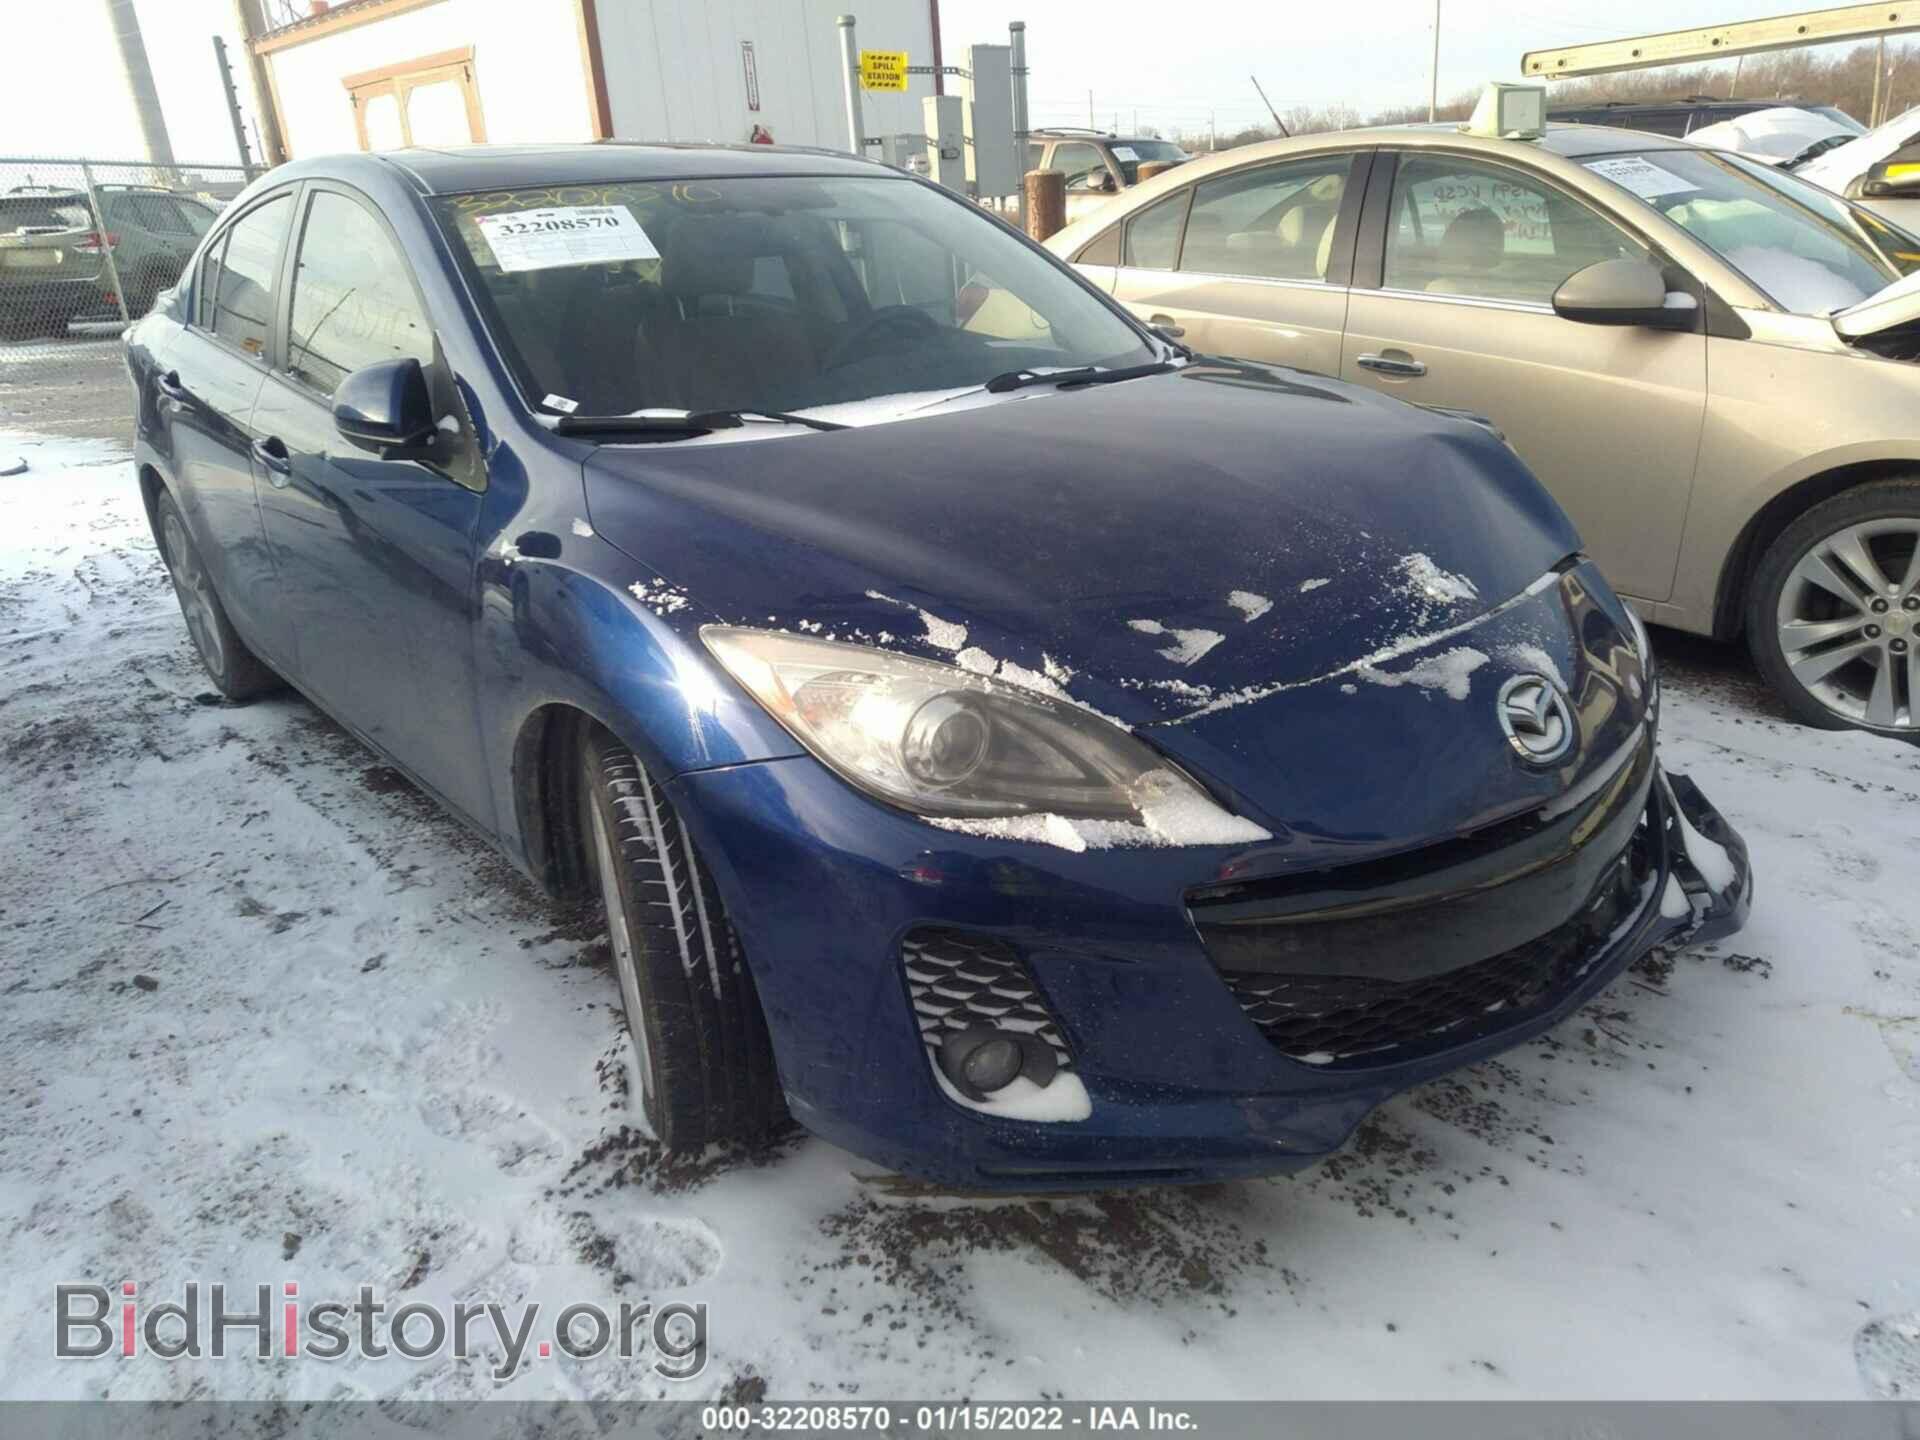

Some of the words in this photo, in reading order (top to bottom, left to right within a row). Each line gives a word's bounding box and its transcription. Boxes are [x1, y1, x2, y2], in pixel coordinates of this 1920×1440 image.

[872, 61, 896, 71] SPILL
[866, 72, 901, 81] STATION
[499, 215, 620, 237] 32208570
